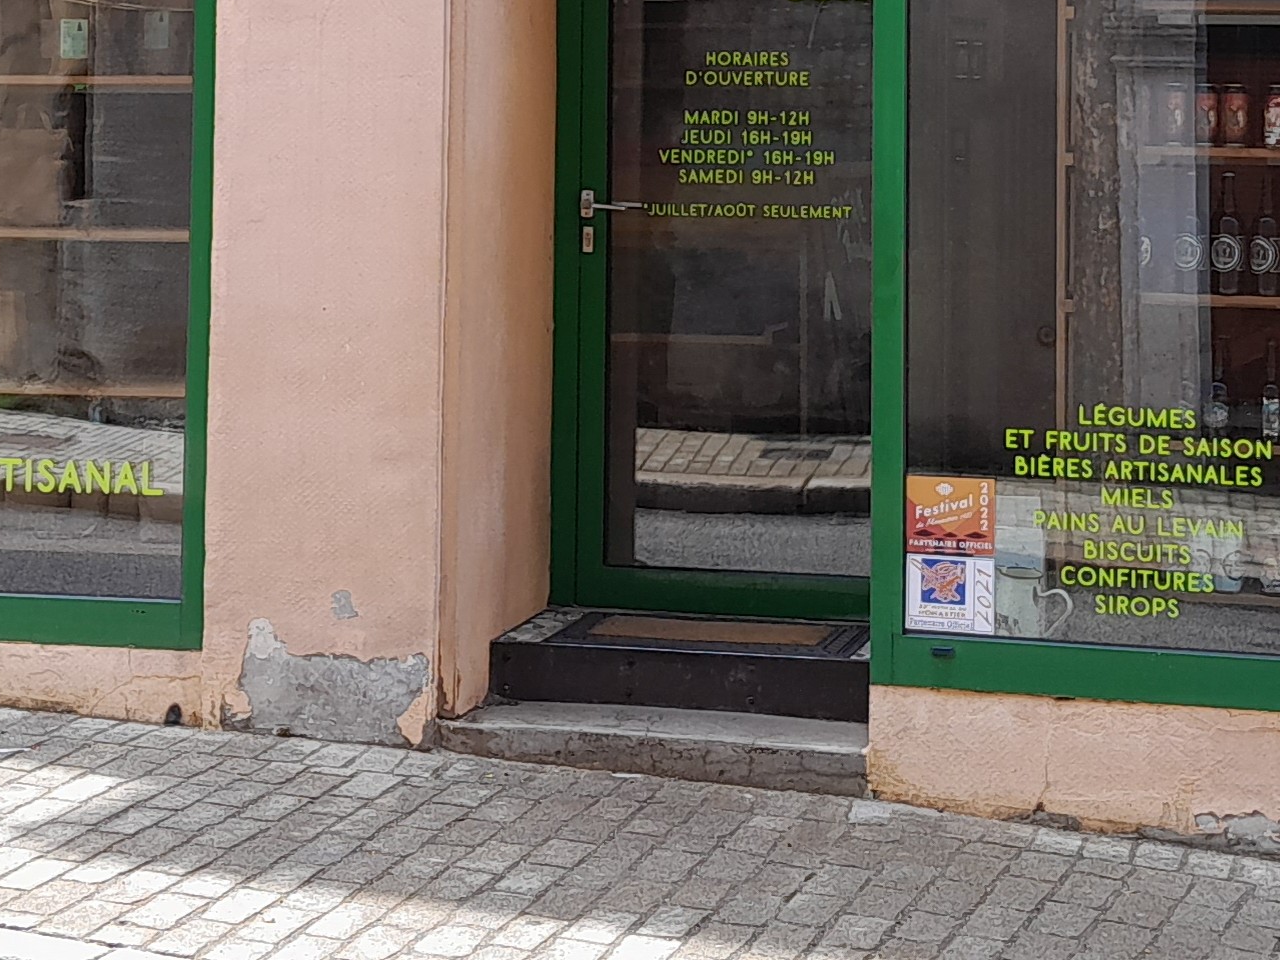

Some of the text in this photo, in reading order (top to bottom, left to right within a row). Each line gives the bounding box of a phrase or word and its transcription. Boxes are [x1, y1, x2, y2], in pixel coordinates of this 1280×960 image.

[706, 51, 789, 67] HORAIRES
[686, 71, 809, 86] D'OUVERTURE
[684, 110, 810, 125] MARDI 9H-12H
[681, 130, 812, 146] JEUDI 16H-19H
[763, 150, 835, 166] 16H-19H
[678, 169, 814, 185] SAMEDI 9H-12H
[763, 205, 852, 219] SEULEMENT
[1078, 404, 1196, 430] LÉGUMES
[1005, 428, 1273, 460] ET FRUITS DE SAISON
[1014, 455, 1263, 487] BIÈRES ARTISANALES
[916, 494, 973, 519] Festival
[980, 483, 989, 530] 2022
[1100, 486, 1174, 510] MIELS
[1032, 510, 1244, 539] PAINS AU LEVAIN
[909, 538, 992, 550] PARTENAIRE OFFICIEL
[1083, 539, 1191, 565] BISCUITS
[1060, 567, 1215, 594] CONFITURES
[1094, 594, 1180, 619] SIROPS
